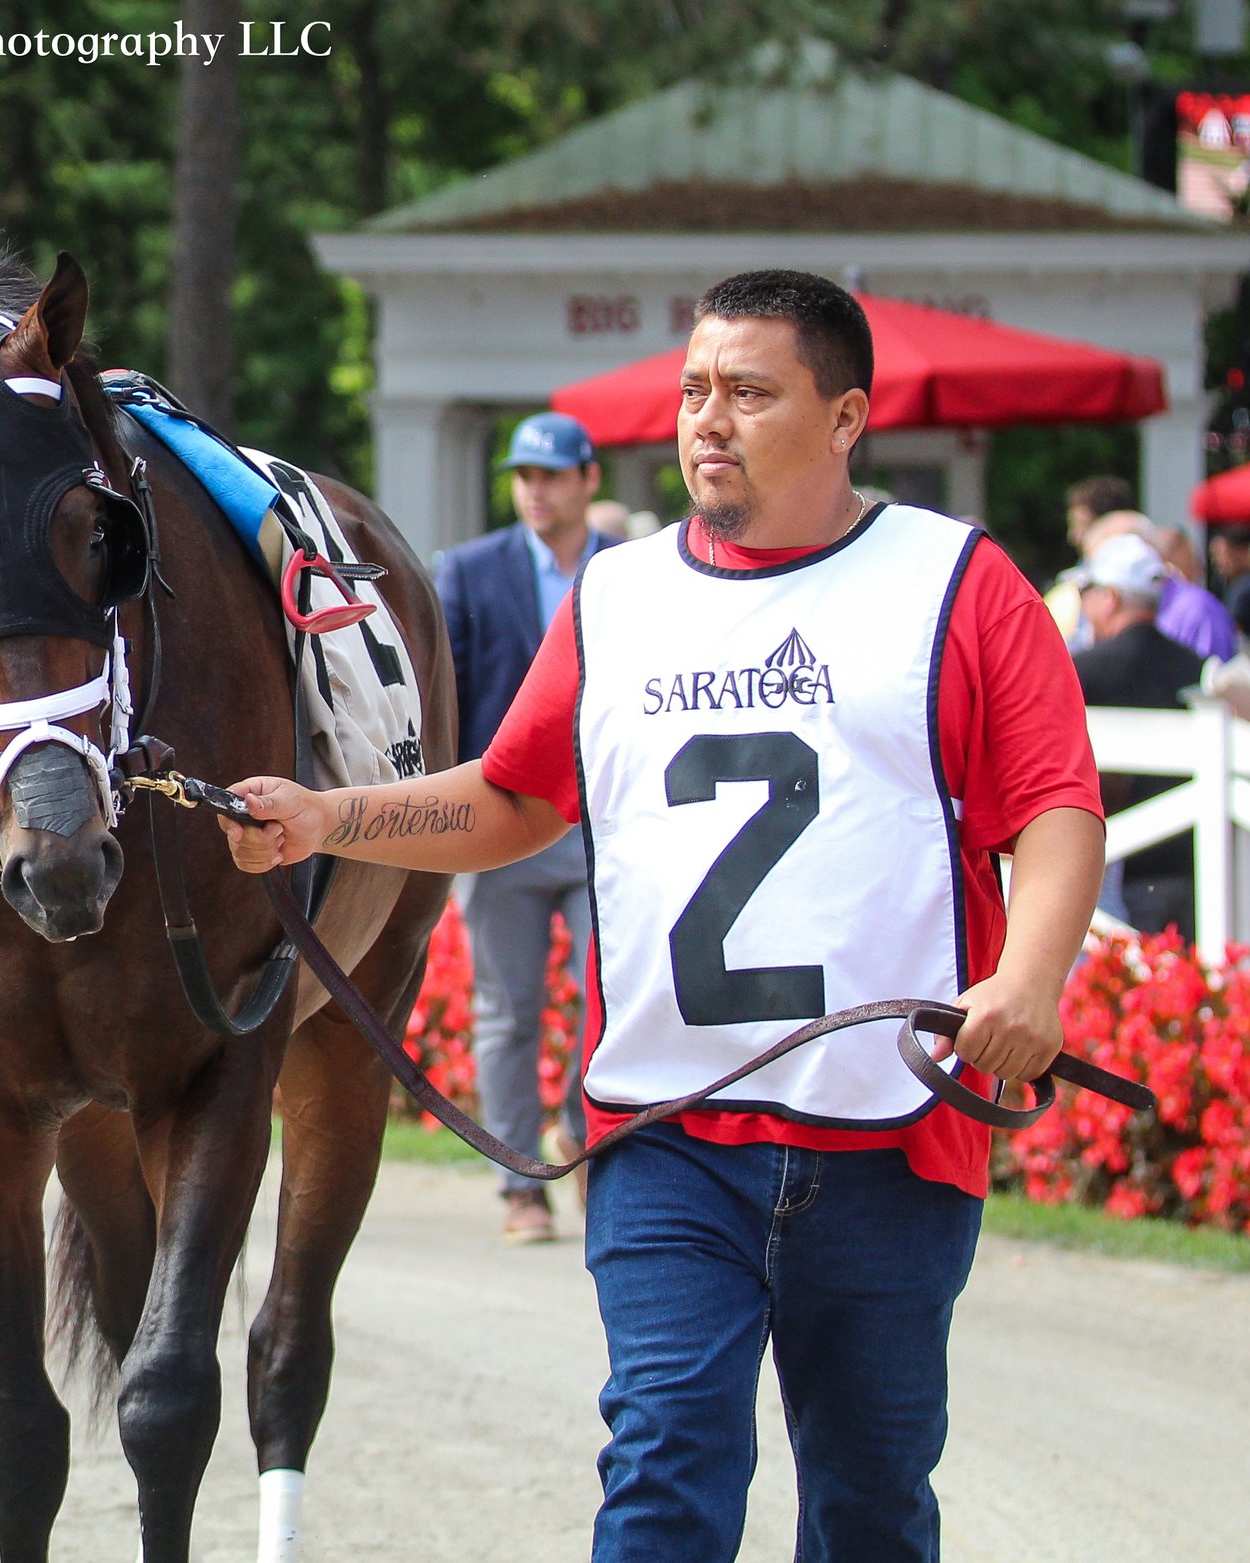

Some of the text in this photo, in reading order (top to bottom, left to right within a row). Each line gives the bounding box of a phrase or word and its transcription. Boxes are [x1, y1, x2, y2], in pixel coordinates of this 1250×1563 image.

[566, 294, 642, 335] BIG
[642, 664, 836, 715] SARATOGA
[322, 794, 476, 848] Hortensia
[664, 731, 826, 1026] 2
